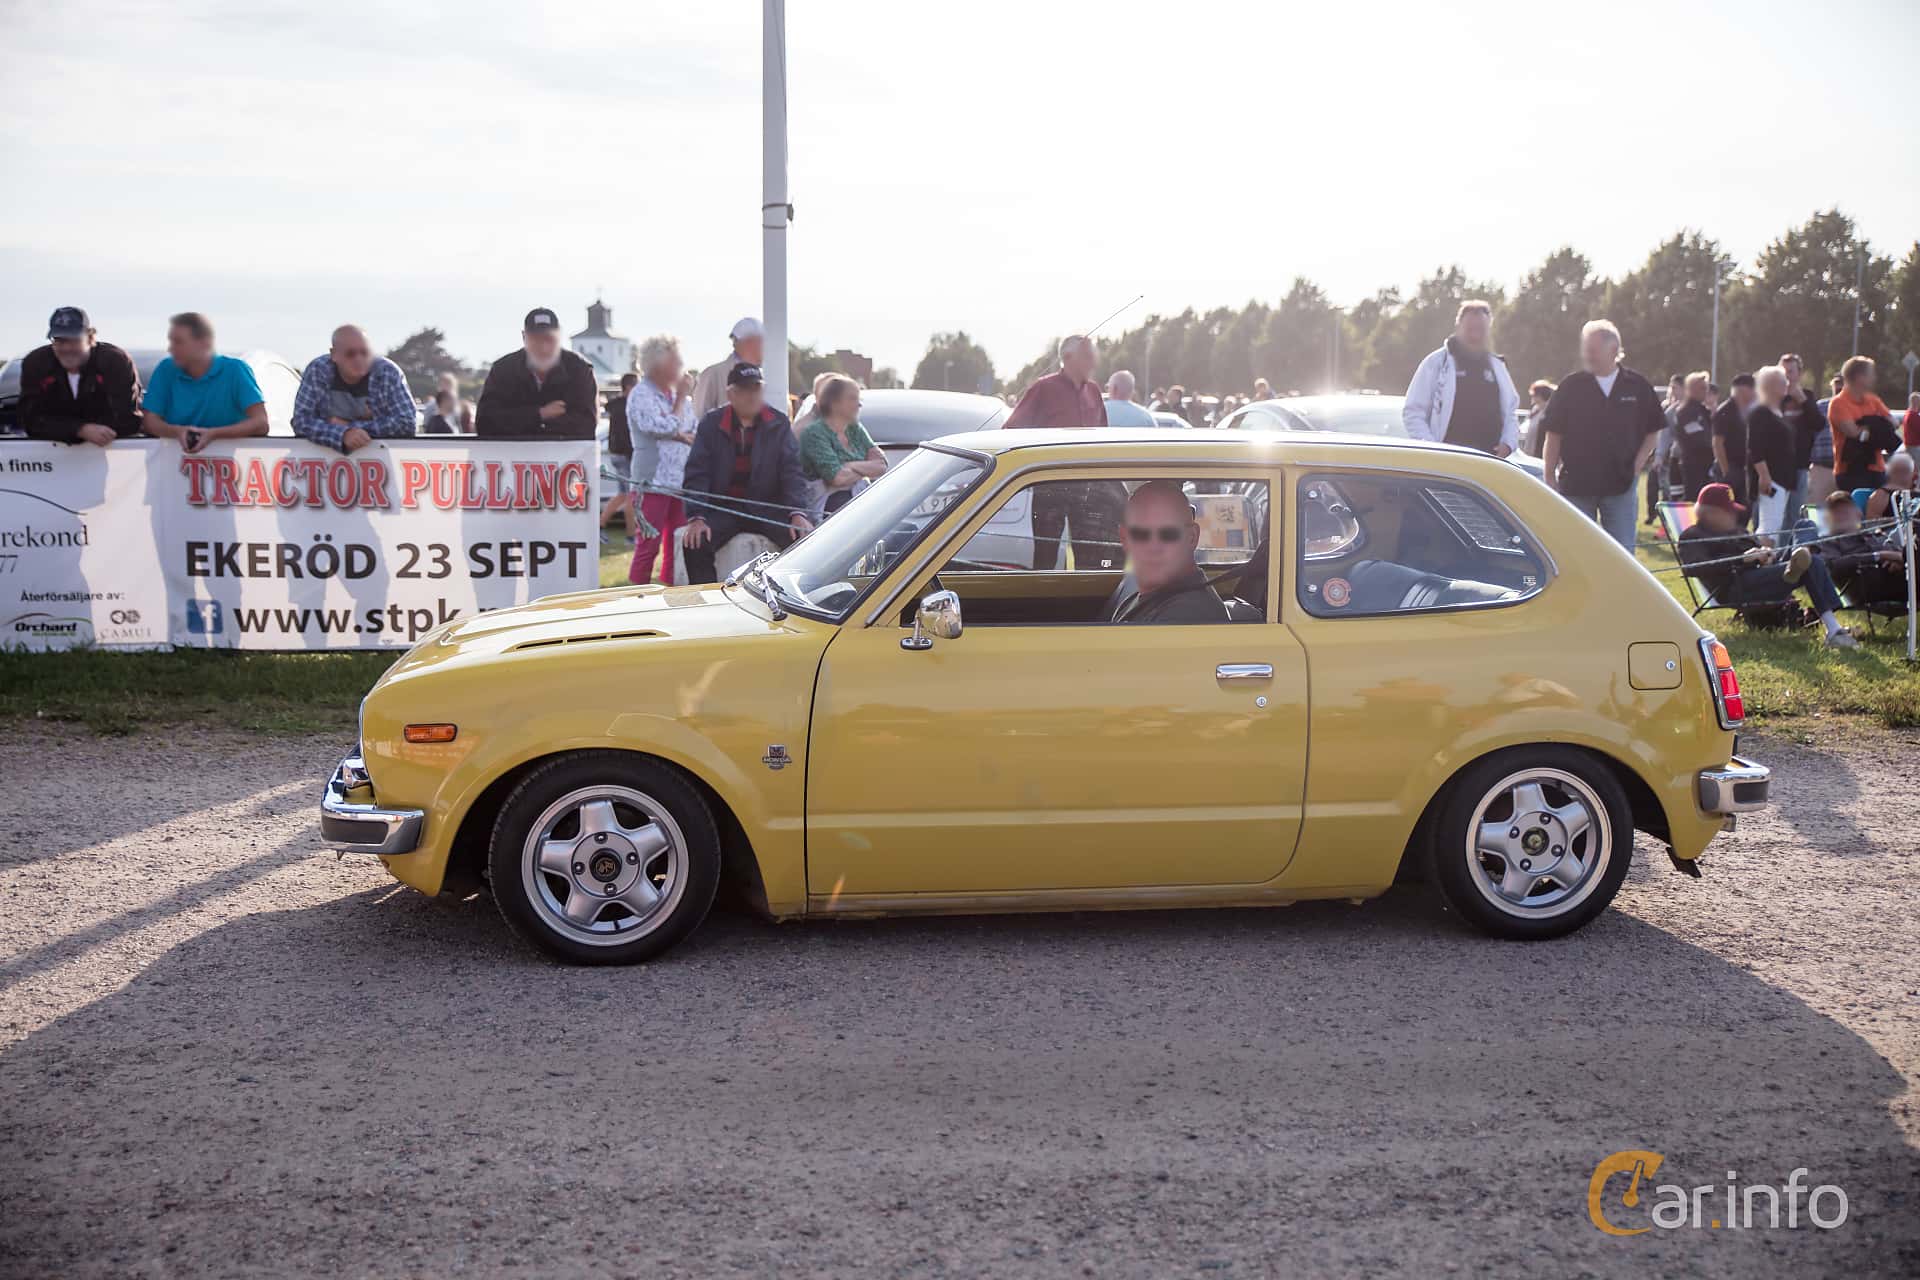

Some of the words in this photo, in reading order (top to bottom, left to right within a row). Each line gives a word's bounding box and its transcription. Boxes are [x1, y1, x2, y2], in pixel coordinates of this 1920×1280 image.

[9, 459, 53, 472] finns
[181, 456, 391, 509] TRACTOR
[400, 459, 588, 511] PULLING
[186, 534, 377, 579] EKERÖD
[396, 543, 451, 579] 23
[469, 541, 587, 578] SEPT
[15, 622, 77, 632] Orchard
